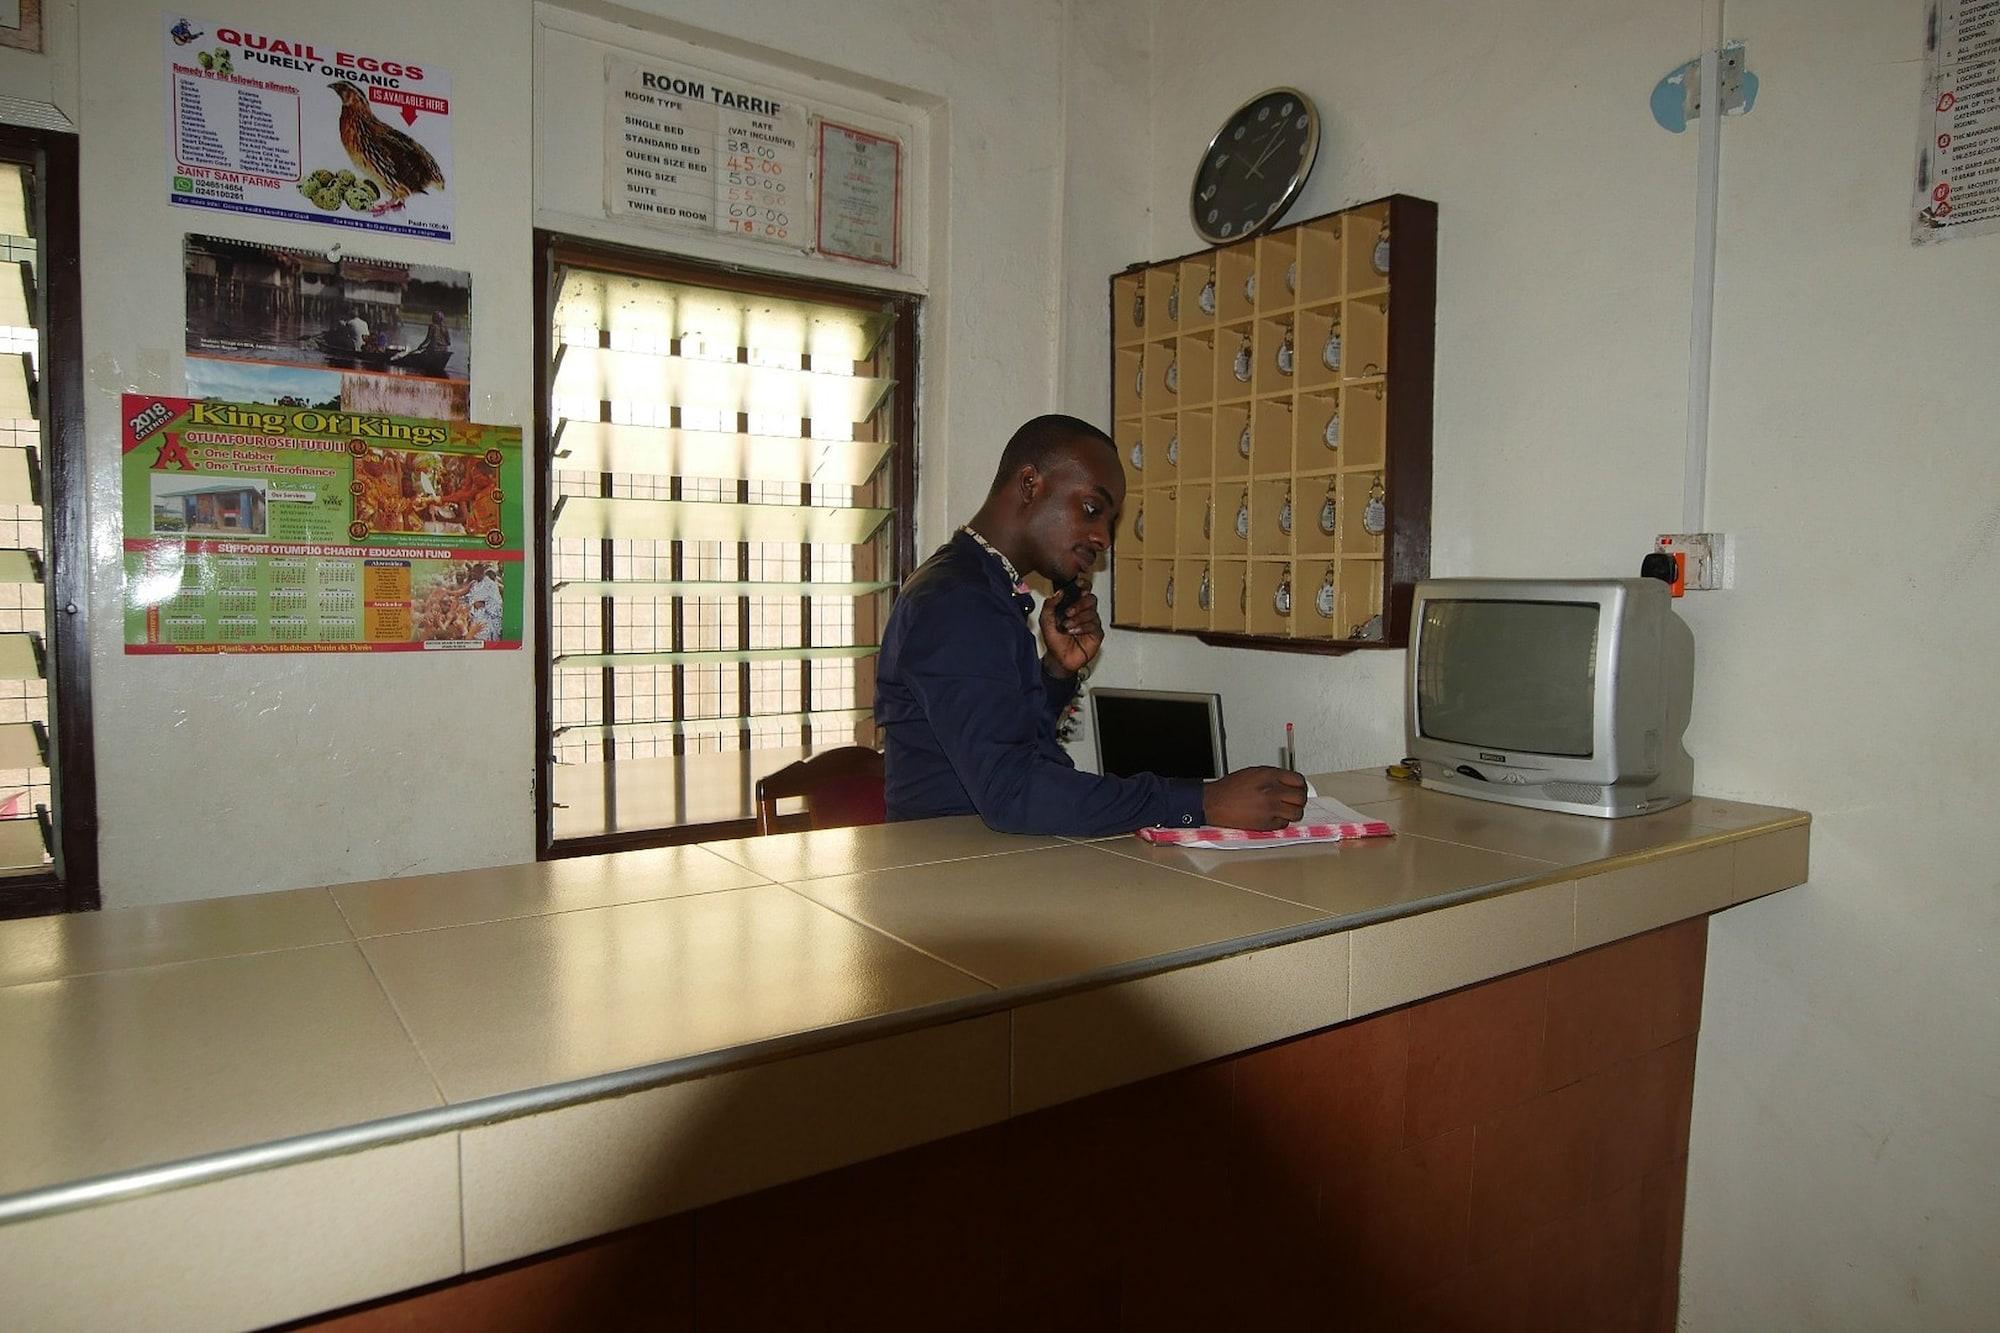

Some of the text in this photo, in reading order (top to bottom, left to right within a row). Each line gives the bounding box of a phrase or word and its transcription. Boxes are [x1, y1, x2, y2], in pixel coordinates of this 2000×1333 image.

[216, 28, 424, 80] QUAIL EGGS
[173, 62, 202, 78] Remedy
[204, 69, 215, 78] for
[230, 74, 264, 89] following
[244, 50, 400, 88] PURELY ORGANIC
[373, 88, 446, 112] IS AVAILABLE HERE
[625, 90, 683, 111] ROOM TYPE
[642, 72, 780, 116] ROOM TARRIF
[625, 116, 684, 136] SINGLE BED
[728, 126, 796, 148] (VAT INCLUSIVE)
[752, 120, 774, 132] RATE
[625, 133, 700, 156] STANDARD BED
[626, 150, 708, 174] QUEEN SIZE BED
[176, 165, 281, 190] SAINT SAM FARMS
[626, 166, 678, 184] KING SIZE
[627, 184, 657, 197] SUITE
[628, 200, 708, 222] TWIN BED ROOM
[130, 402, 166, 434] 2018
[134, 411, 174, 441] CALENDAR
[188, 402, 448, 446] King Of Kings
[186, 432, 263, 448] OTUMFOUR
[266, 434, 297, 450] OSEI
[298, 438, 332, 451] TUTU
[204, 448, 276, 462] One Rubber
[204, 461, 336, 478] One Trust Microfinance
[218, 543, 268, 554] SUPPORT
[320, 547, 368, 558] CHARITY
[369, 548, 424, 559] EDUCATION
[424, 549, 452, 559] FUND
